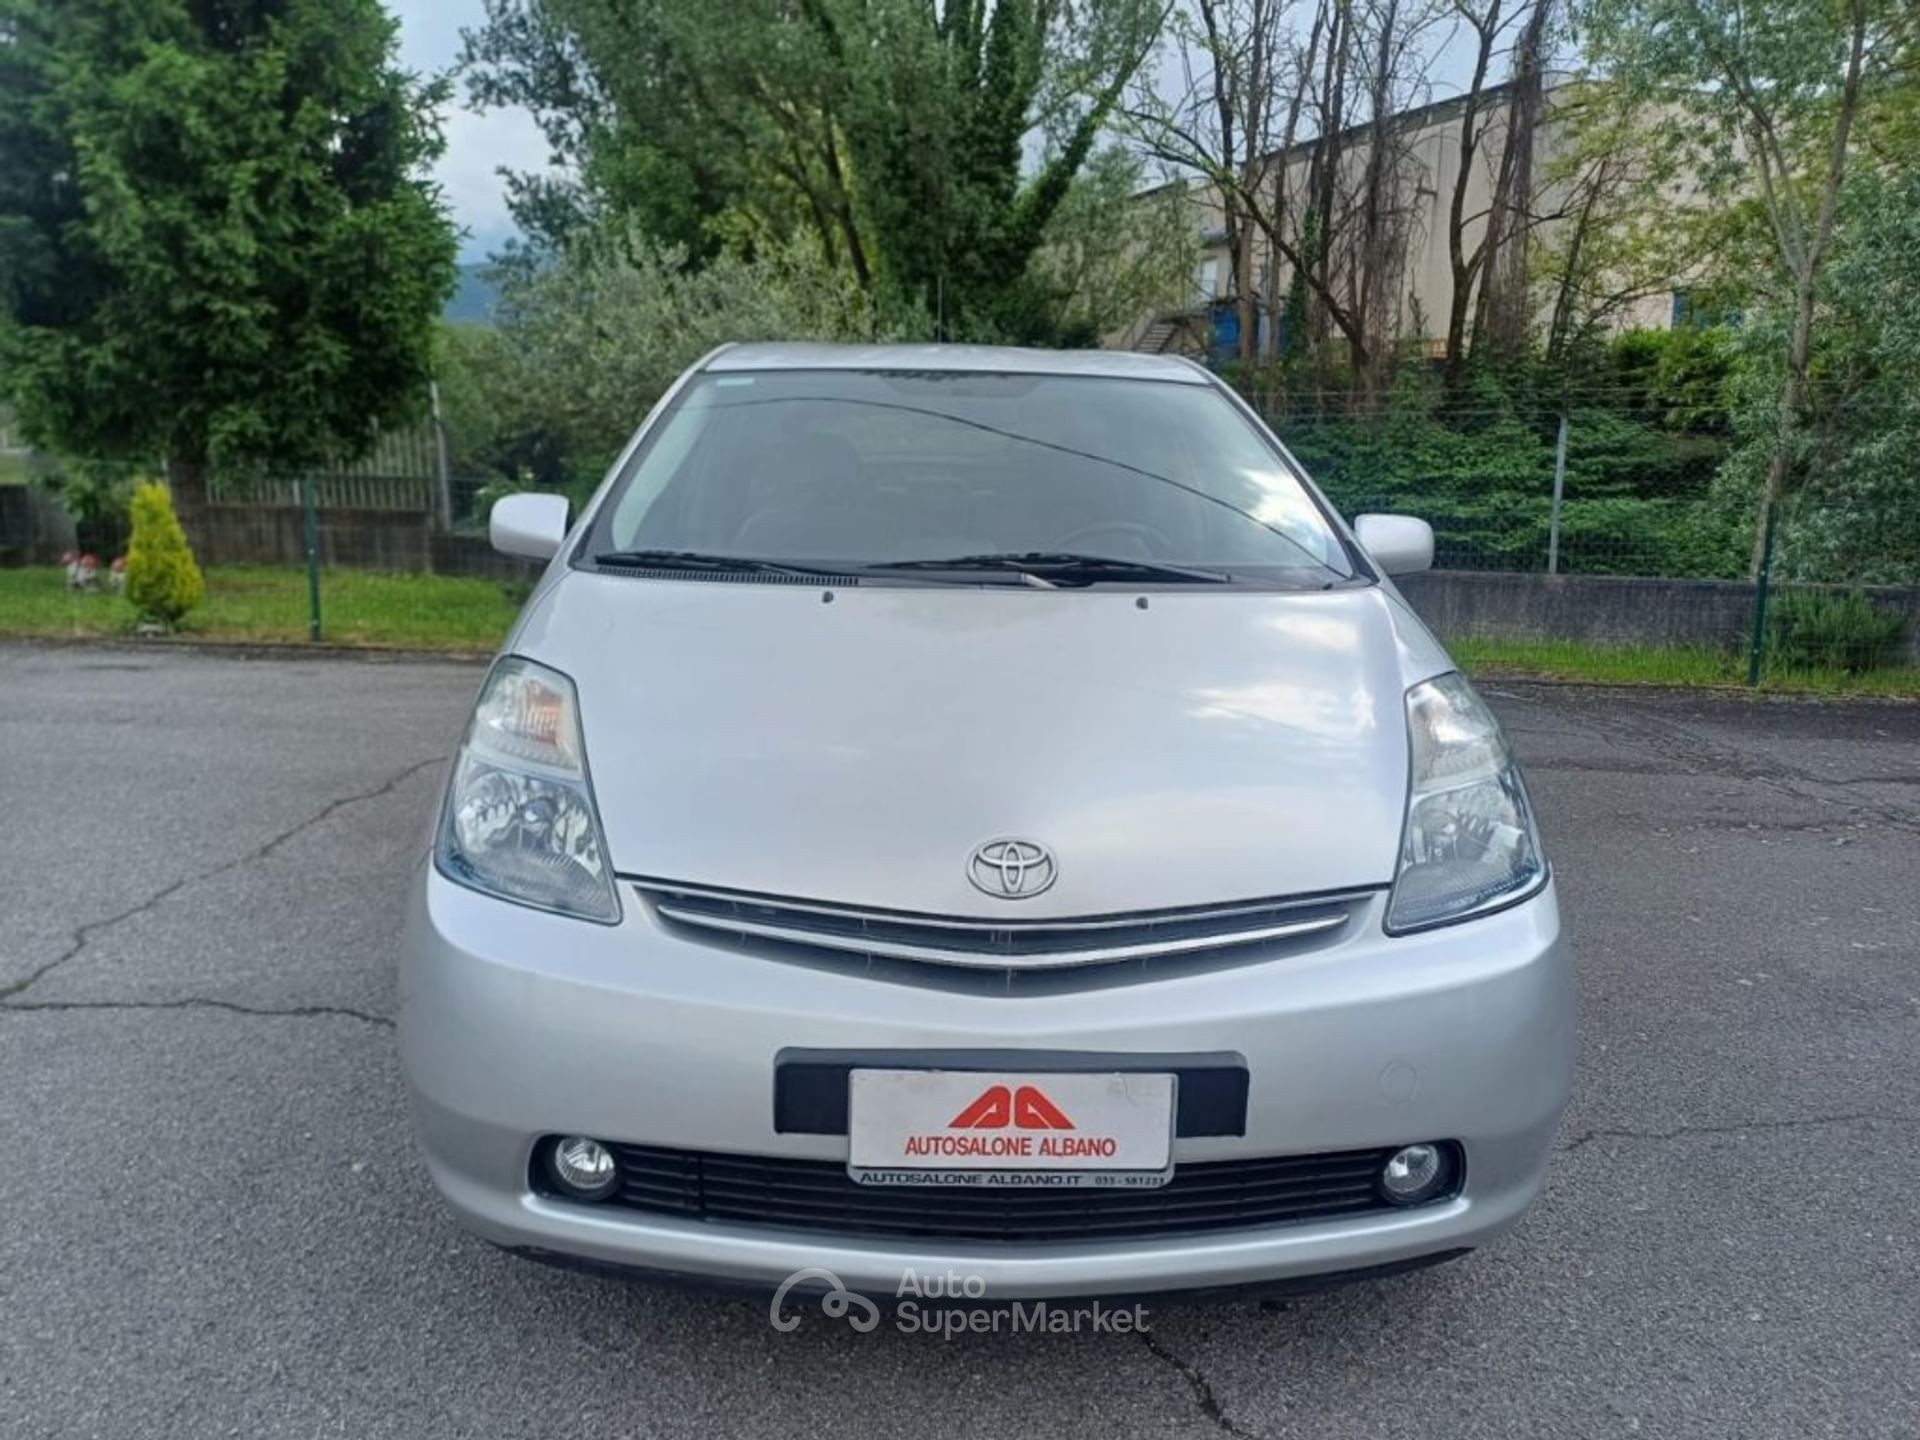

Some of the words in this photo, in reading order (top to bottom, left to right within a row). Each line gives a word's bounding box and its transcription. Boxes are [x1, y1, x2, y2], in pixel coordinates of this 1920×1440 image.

[905, 1137, 1032, 1156] AUTOSALONE
[1039, 1138, 1116, 1157] ALBANO
[861, 1172, 982, 1185] AUTOSALONE
